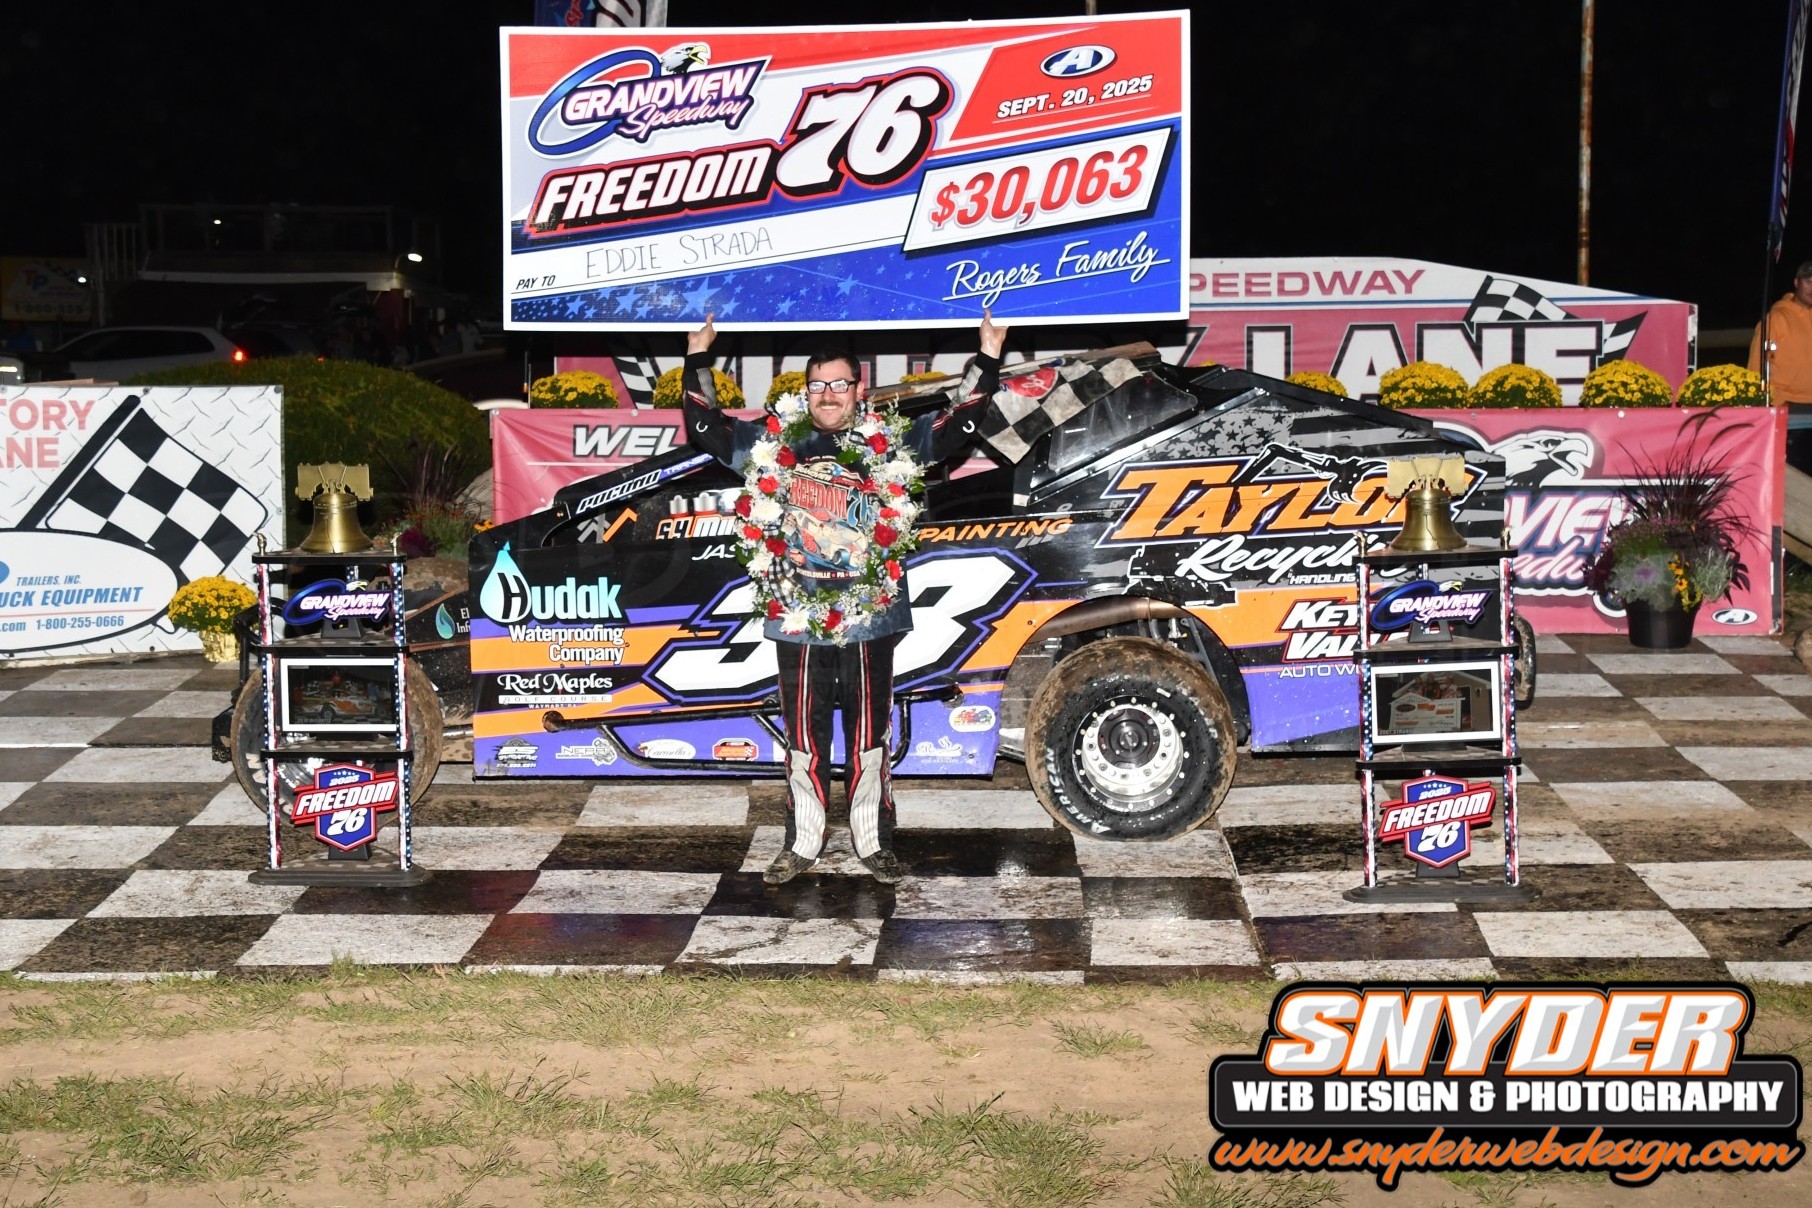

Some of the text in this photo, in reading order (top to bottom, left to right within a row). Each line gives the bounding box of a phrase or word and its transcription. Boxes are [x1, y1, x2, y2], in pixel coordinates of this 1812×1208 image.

[565, 66, 756, 121] GRANDVIEW
[997, 75, 1153, 118] SEPT. 20, 2025
[619, 97, 750, 138] Speedway
[535, 72, 941, 224] FREEDOM 76
[930, 144, 1149, 229] $30,063
[586, 227, 773, 278] EDDIE STRADA
[516, 275, 556, 290] PAY TO
[946, 232, 1158, 309] Rogers Family
[0, 399, 95, 431] ORY
[0, 437, 60, 469] NE
[576, 469, 662, 514] POCONO
[787, 475, 847, 520] REEDOM
[919, 517, 1074, 543] PAINTING
[63, 574, 82, 585] INC.
[482, 555, 622, 623] Hudak
[41, 587, 144, 607] EQUIPMENT
[300, 593, 390, 610] GRANDVIEW
[1389, 593, 1486, 613] GRANDVIEW
[36, 615, 125, 630] 1-800-255-0666
[324, 605, 387, 621] Speedway
[1415, 607, 1481, 625] Speedway
[508, 624, 625, 645] Waterproofing
[549, 644, 625, 666] Company
[497, 673, 613, 695] Red Maples
[1279, 665, 1331, 679] AUTO
[295, 781, 397, 816] FREEDOM
[1384, 791, 1491, 832] FREEDOM
[327, 807, 368, 836] 76
[1418, 821, 1461, 852] 76
